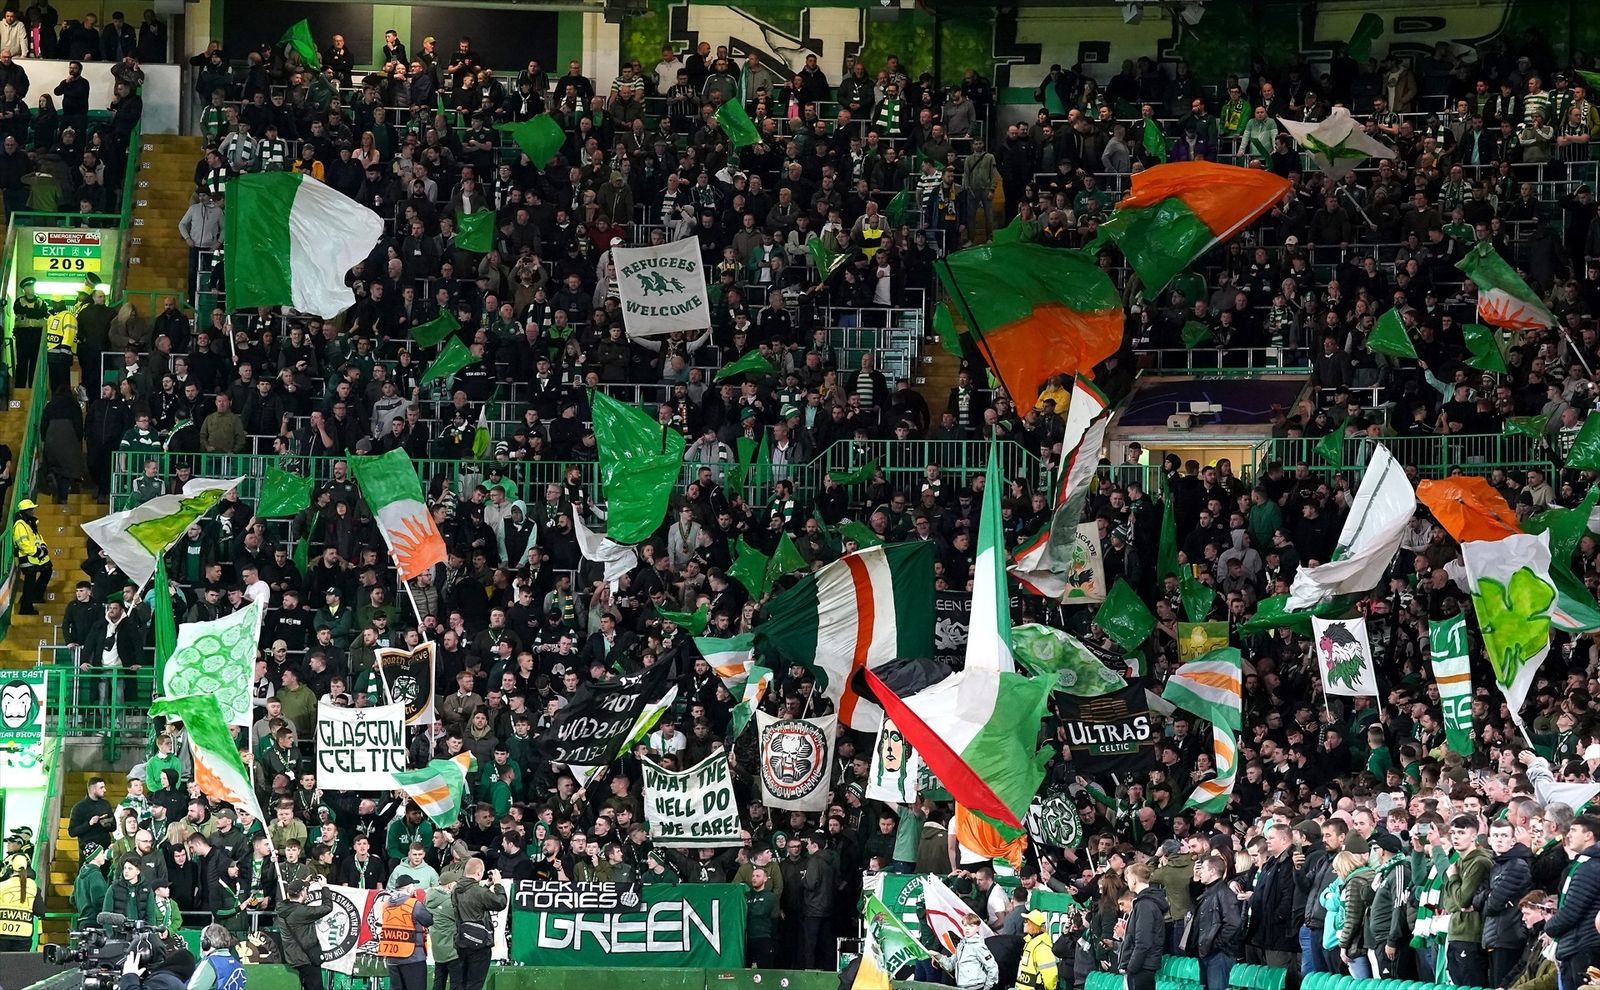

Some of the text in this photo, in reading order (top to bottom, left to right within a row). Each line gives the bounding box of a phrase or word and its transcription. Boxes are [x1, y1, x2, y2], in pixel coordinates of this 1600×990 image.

[42, 246, 66, 256] EXIT
[49, 258, 85, 270] 209
[621, 257, 696, 278] REFUGEES
[626, 295, 703, 317] WELCOME
[319, 720, 403, 747] GLASGOW
[1067, 716, 1151, 745] ULTRAS
[1099, 742, 1130, 753] CELTIC
[319, 749, 405, 773] CELTIC
[645, 757, 727, 793] WHAT THE
[655, 787, 730, 818] HELL DO
[660, 814, 740, 837] WE CARE!
[520, 880, 616, 892] FUCK THE
[515, 891, 618, 908] TORIES
[380, 930, 410, 941] EWARD
[537, 897, 721, 956] GREEN
